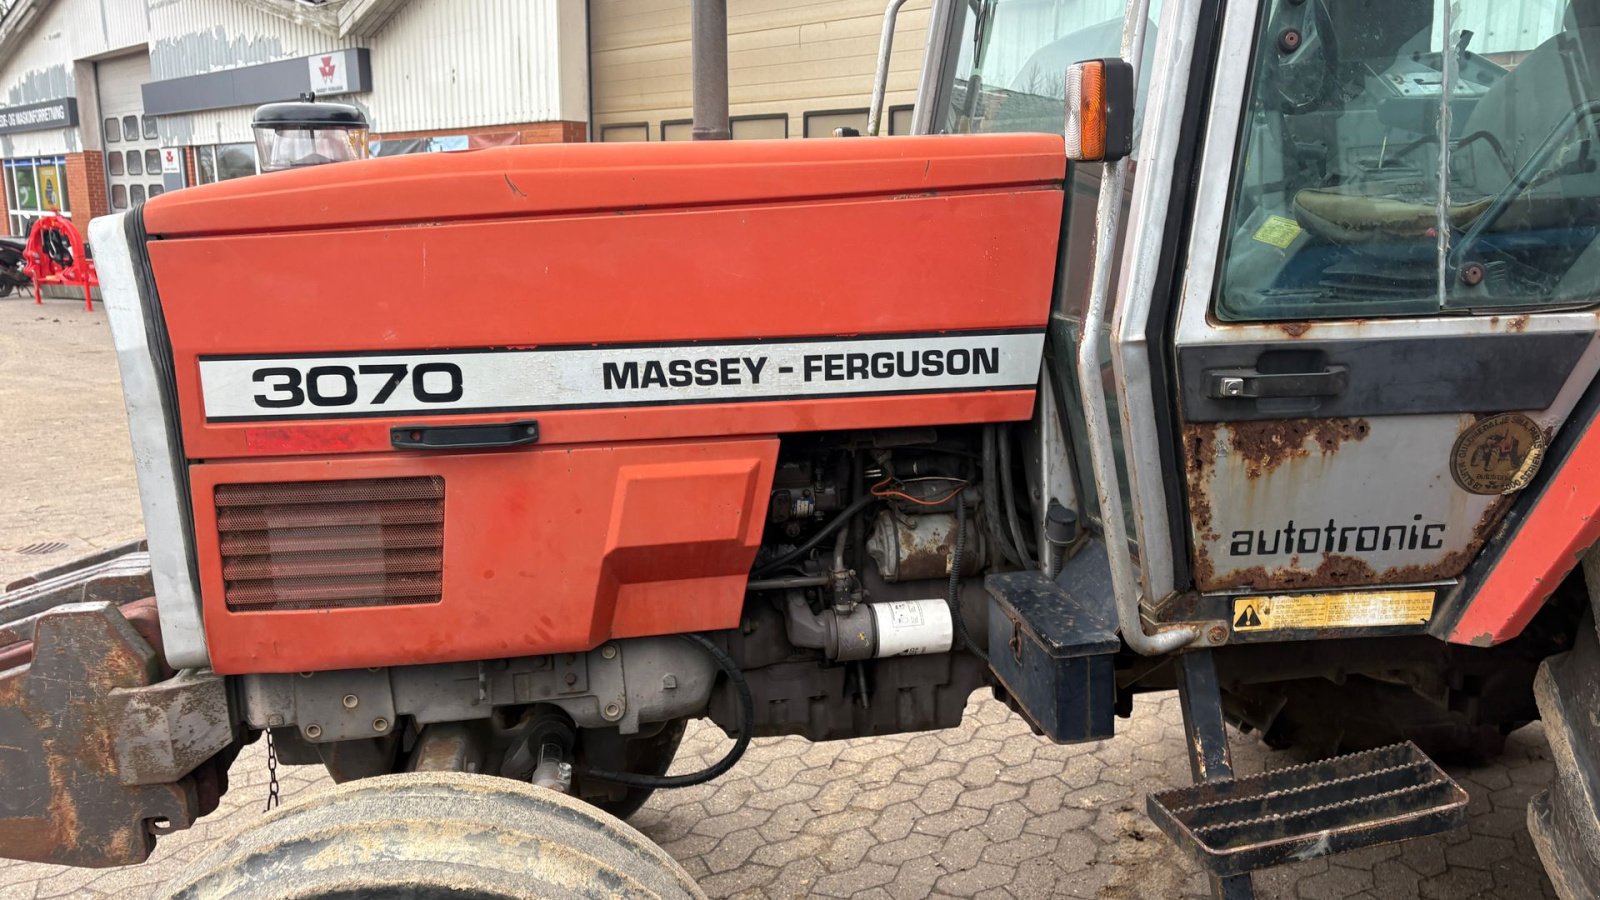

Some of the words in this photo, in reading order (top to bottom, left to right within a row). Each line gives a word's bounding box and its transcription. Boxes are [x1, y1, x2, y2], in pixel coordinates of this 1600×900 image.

[252, 362, 463, 408] 3070
[602, 356, 768, 390] MASSEY
[803, 347, 1000, 382] FERGUSON
[1520, 452, 1543, 482] SERIEN
[1229, 513, 1446, 556] autotronic
